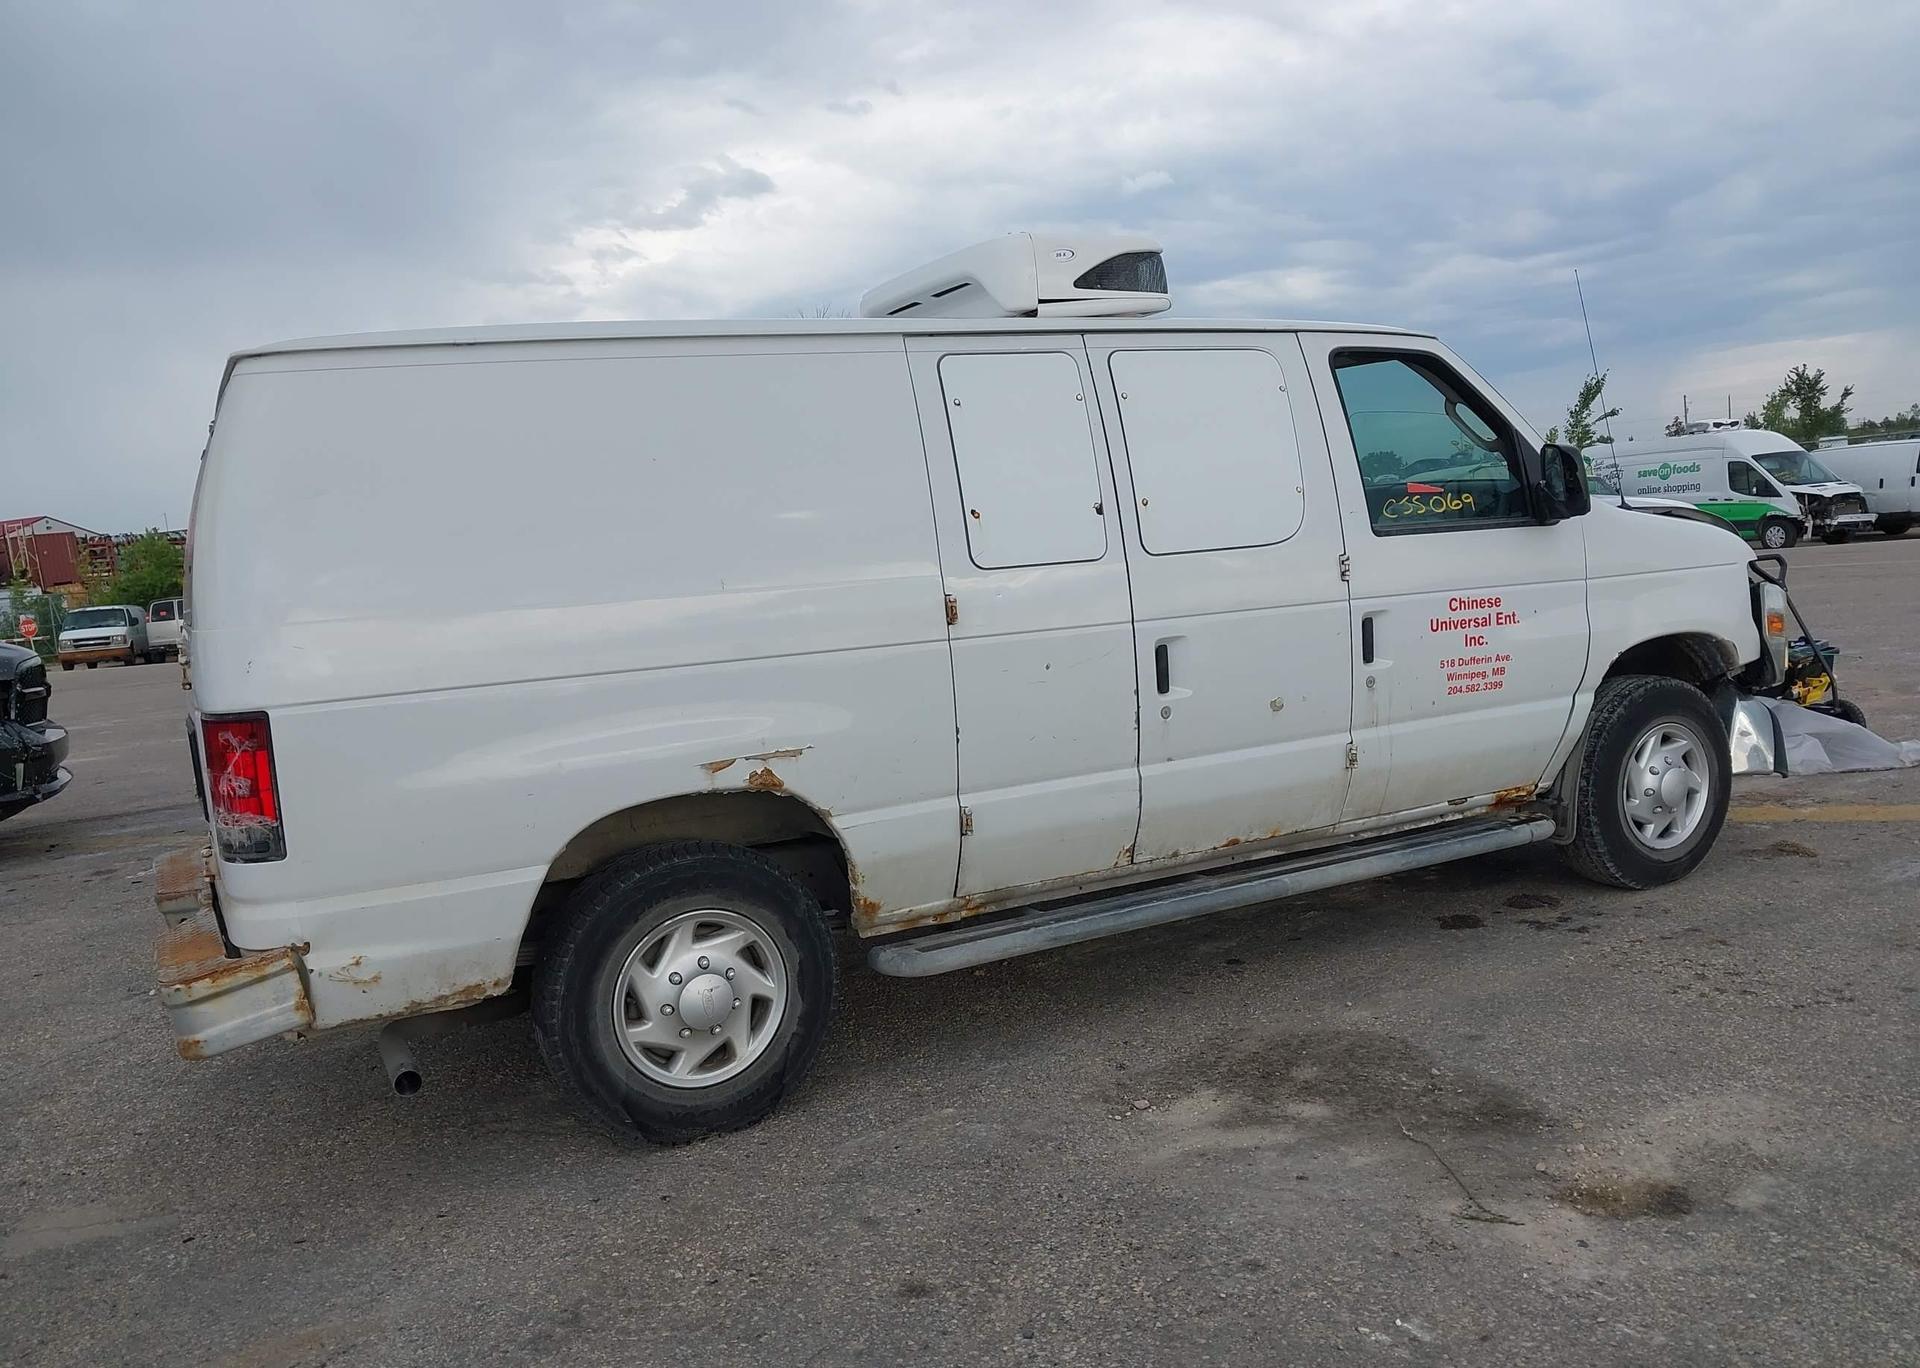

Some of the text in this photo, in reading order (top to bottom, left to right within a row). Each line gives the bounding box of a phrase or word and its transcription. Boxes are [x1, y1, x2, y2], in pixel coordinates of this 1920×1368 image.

[1637, 468, 1658, 478] save
[1673, 462, 1702, 474] foods
[1637, 482, 1701, 495] online shopping
[1449, 597, 1501, 612] Chinese
[20, 624, 36, 632] STOP
[1430, 612, 1520, 632] Universal Ent.
[1464, 634, 1488, 647] Inc.
[1440, 654, 1513, 669] 518 Dufferin Ave.
[1446, 667, 1506, 682] Winnipeg, MB
[1447, 681, 1503, 696] 204.582.3399
